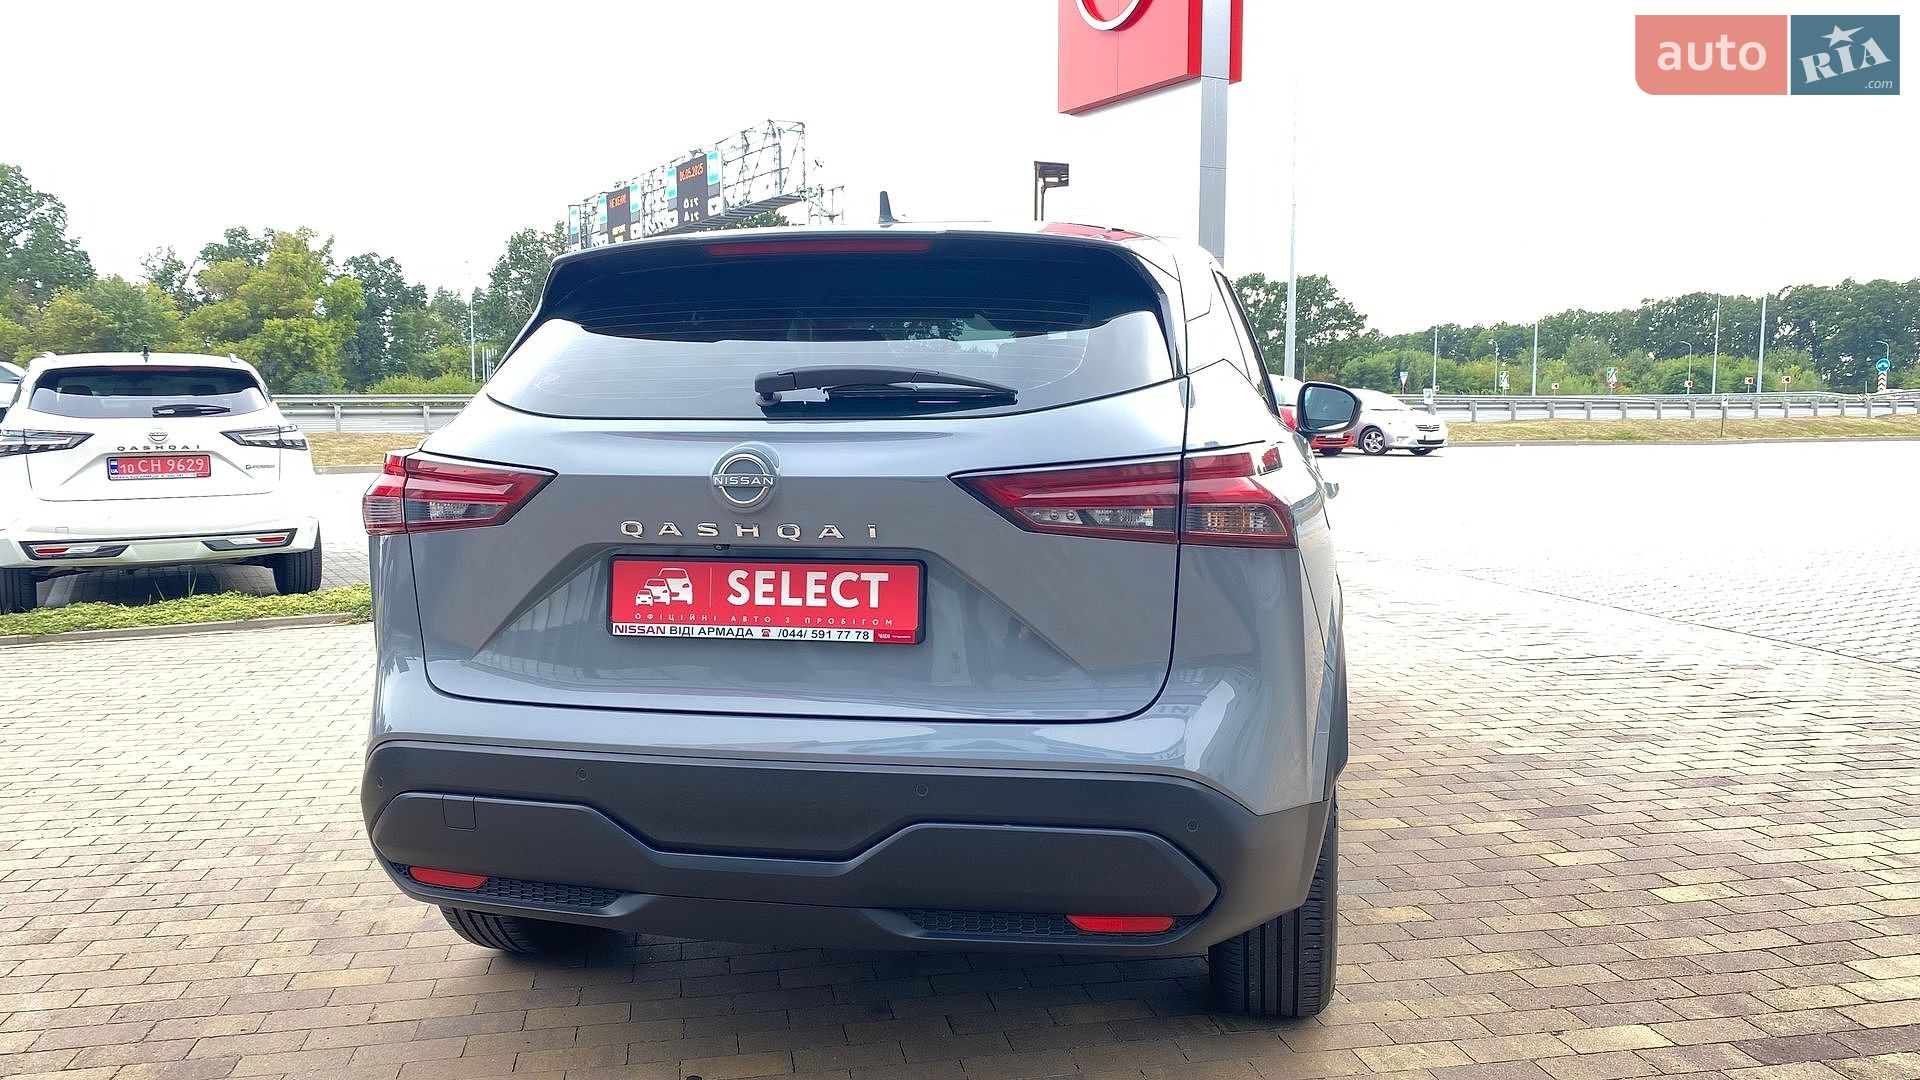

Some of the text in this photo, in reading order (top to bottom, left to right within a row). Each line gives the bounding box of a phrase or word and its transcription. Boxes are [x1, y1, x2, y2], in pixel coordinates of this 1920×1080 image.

[120, 464, 135, 474] 10
[137, 459, 161, 473] CH
[166, 458, 204, 472] 9629
[713, 476, 774, 486] NISSAN
[620, 520, 878, 542] QASHQAI
[727, 569, 889, 608] SELECT
[634, 612, 717, 622] ОФІЦІЙНІ
[730, 614, 771, 623] АВТО
[804, 616, 893, 626] ПРОБІГОМ
[614, 624, 870, 640] NISSAN ВІДІ АРМАДА /044/ 591 77 78
